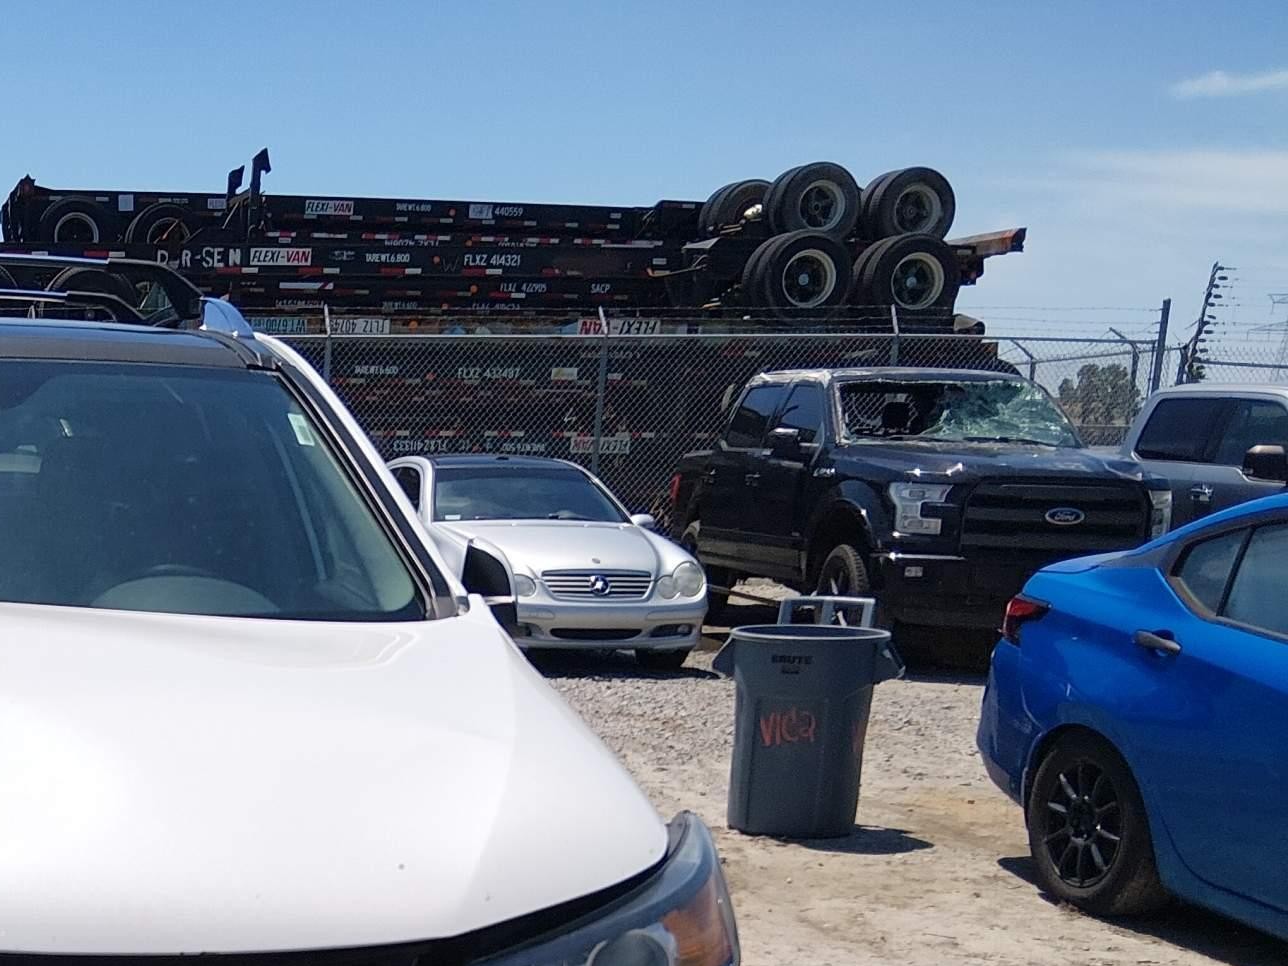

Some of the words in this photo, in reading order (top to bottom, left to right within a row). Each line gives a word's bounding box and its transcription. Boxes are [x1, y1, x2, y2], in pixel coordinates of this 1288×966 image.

[306, 201, 353, 215] FLEXI-VAN
[494, 206, 524, 217] 440559
[251, 249, 311, 265] FLEXI-VAN
[463, 254, 488, 266] FLXZ
[490, 254, 521, 267] 414321
[1054, 511, 1076, 521] Ford
